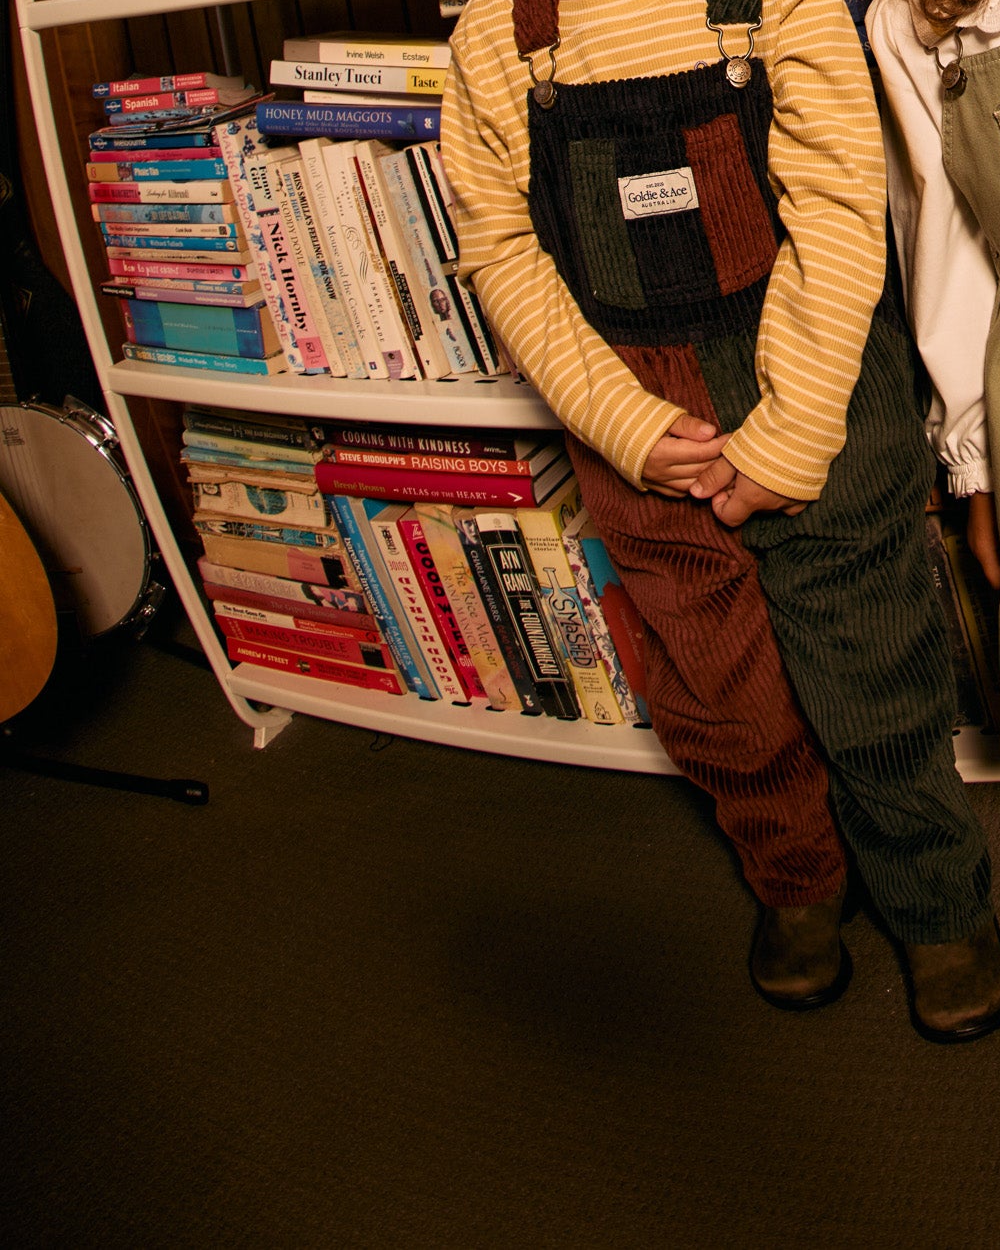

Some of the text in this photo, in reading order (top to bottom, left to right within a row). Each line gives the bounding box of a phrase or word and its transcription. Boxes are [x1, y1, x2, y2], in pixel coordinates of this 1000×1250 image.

[294, 67, 439, 88] Stanley Tucci Taste
[112, 82, 139, 93] Italian
[125, 97, 159, 109] Spanish
[335, 111, 393, 124] MAGGOTS
[628, 187, 687, 203] Goldie & Ace
[642, 199, 676, 208] AUSTRALIA
[267, 221, 309, 333] Nick Hornby
[341, 431, 472, 455] COOKING WITH KINDNESS
[410, 456, 509, 474] RAISING BOYS
[499, 546, 521, 570] AYN
[502, 571, 534, 593] RAND
